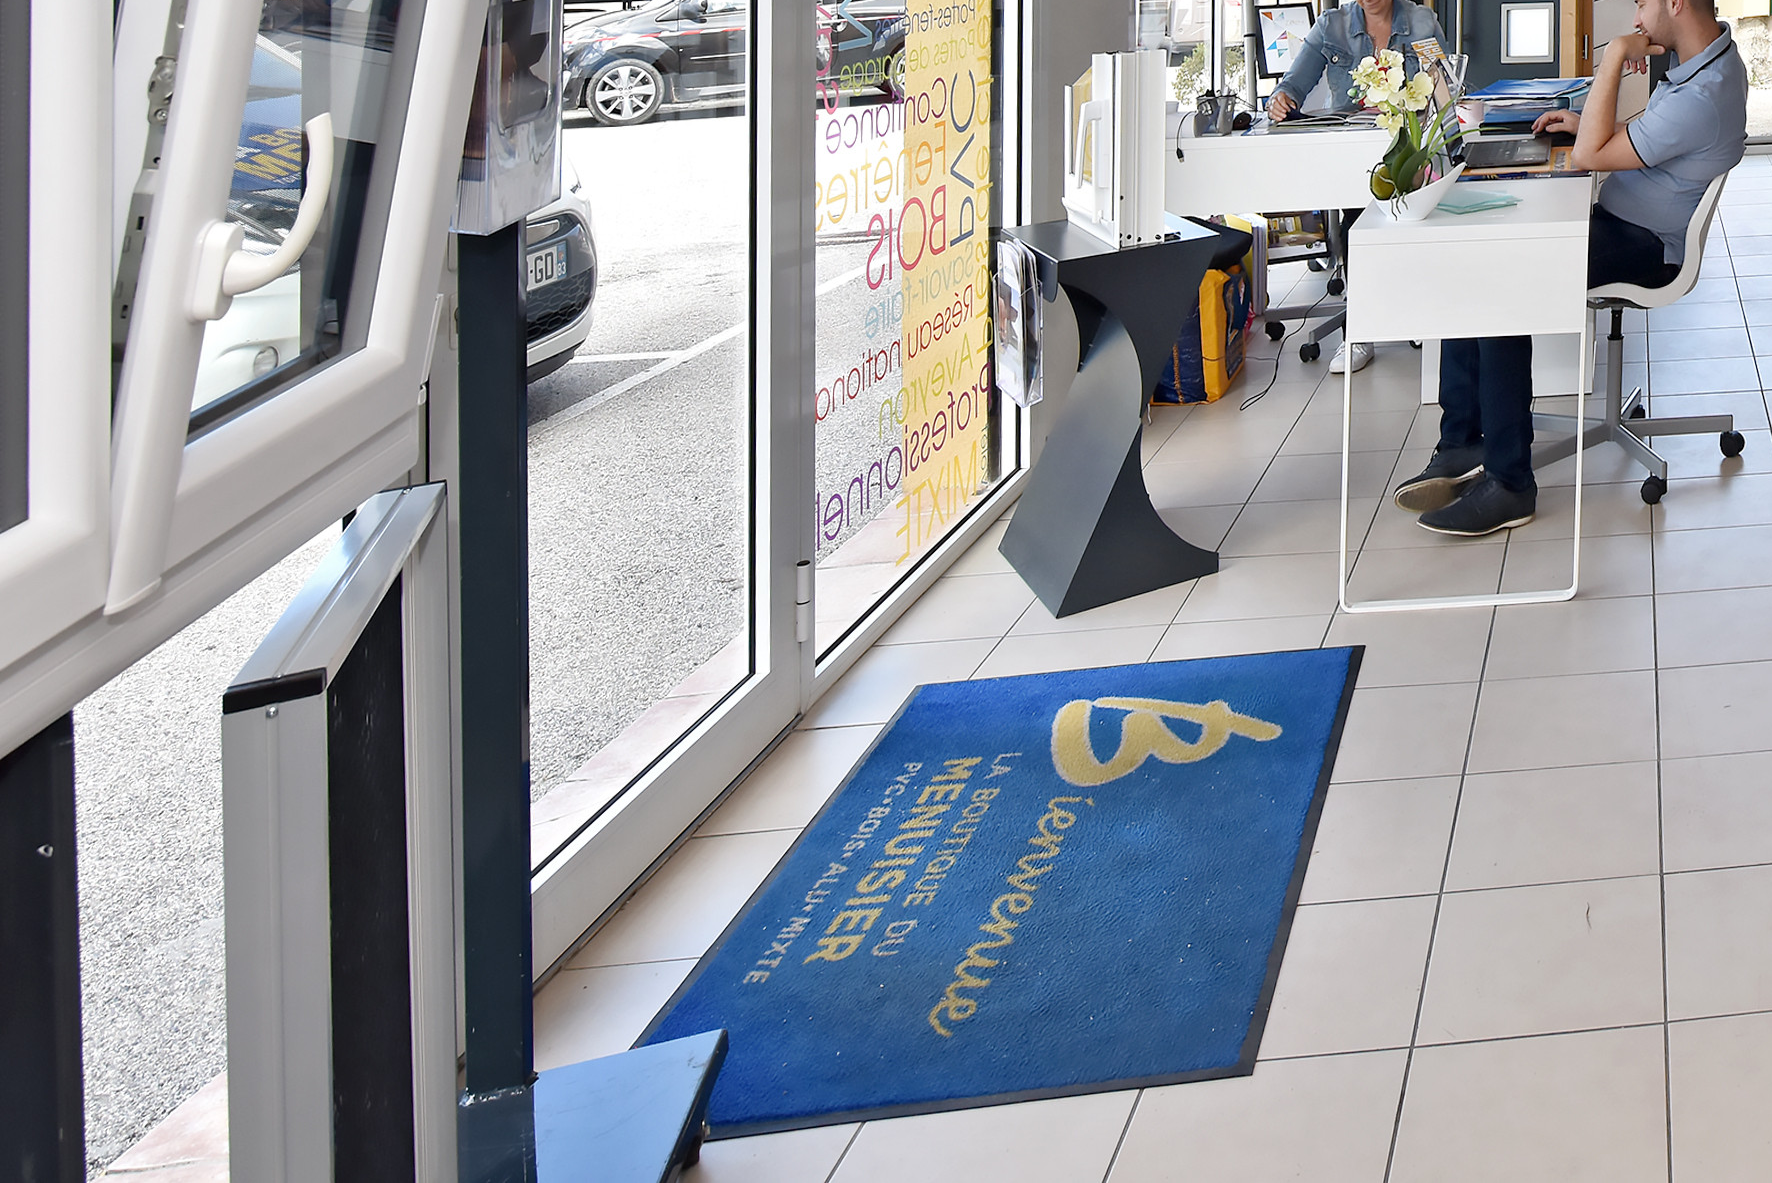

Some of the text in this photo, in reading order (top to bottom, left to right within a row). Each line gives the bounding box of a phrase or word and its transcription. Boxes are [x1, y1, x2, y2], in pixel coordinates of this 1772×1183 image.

[743, 915, 812, 986] MIXTE
[802, 755, 983, 965] MENUISIER
[870, 751, 1024, 958] LA BOUTIQUE DU
